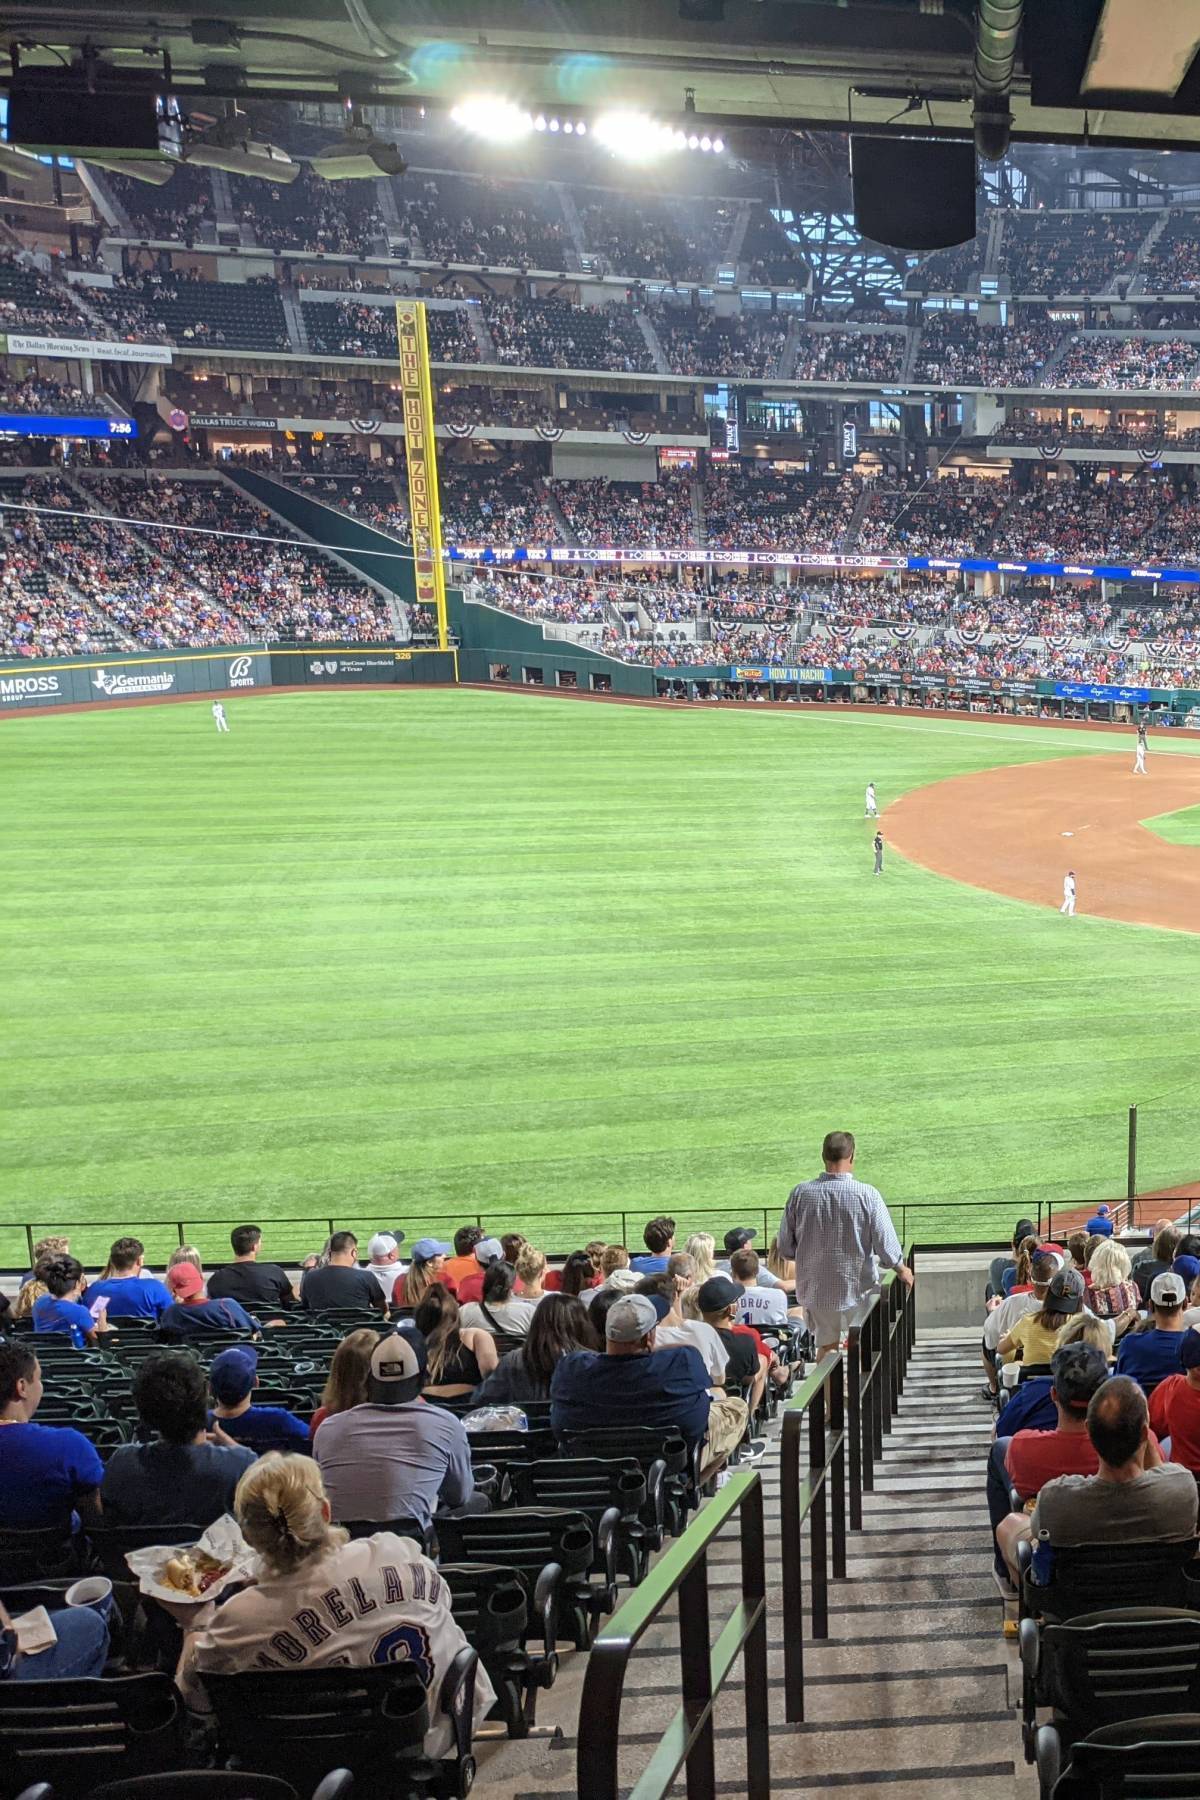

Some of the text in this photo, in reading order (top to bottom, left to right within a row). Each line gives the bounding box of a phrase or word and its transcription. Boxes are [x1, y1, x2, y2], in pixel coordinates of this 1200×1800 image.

[13, 340, 90, 352] The Dallas Morning News
[403, 336, 416, 385] THE
[109, 423, 131, 434] 7:56
[191, 418, 219, 426] DALLAS
[249, 420, 276, 428] WORLD
[407, 399, 421, 448] HOT
[727, 424, 735, 447] TRULY
[844, 427, 852, 451] TRULY
[412, 463, 427, 526] ZONE
[117, 671, 174, 686] Germania
[769, 668, 787, 679] HOW
[790, 668, 798, 679] TO
[230, 677, 254, 687] SPORTS
[2, 694, 23, 702] GROUP
[738, 1298, 770, 1310] DRUS
